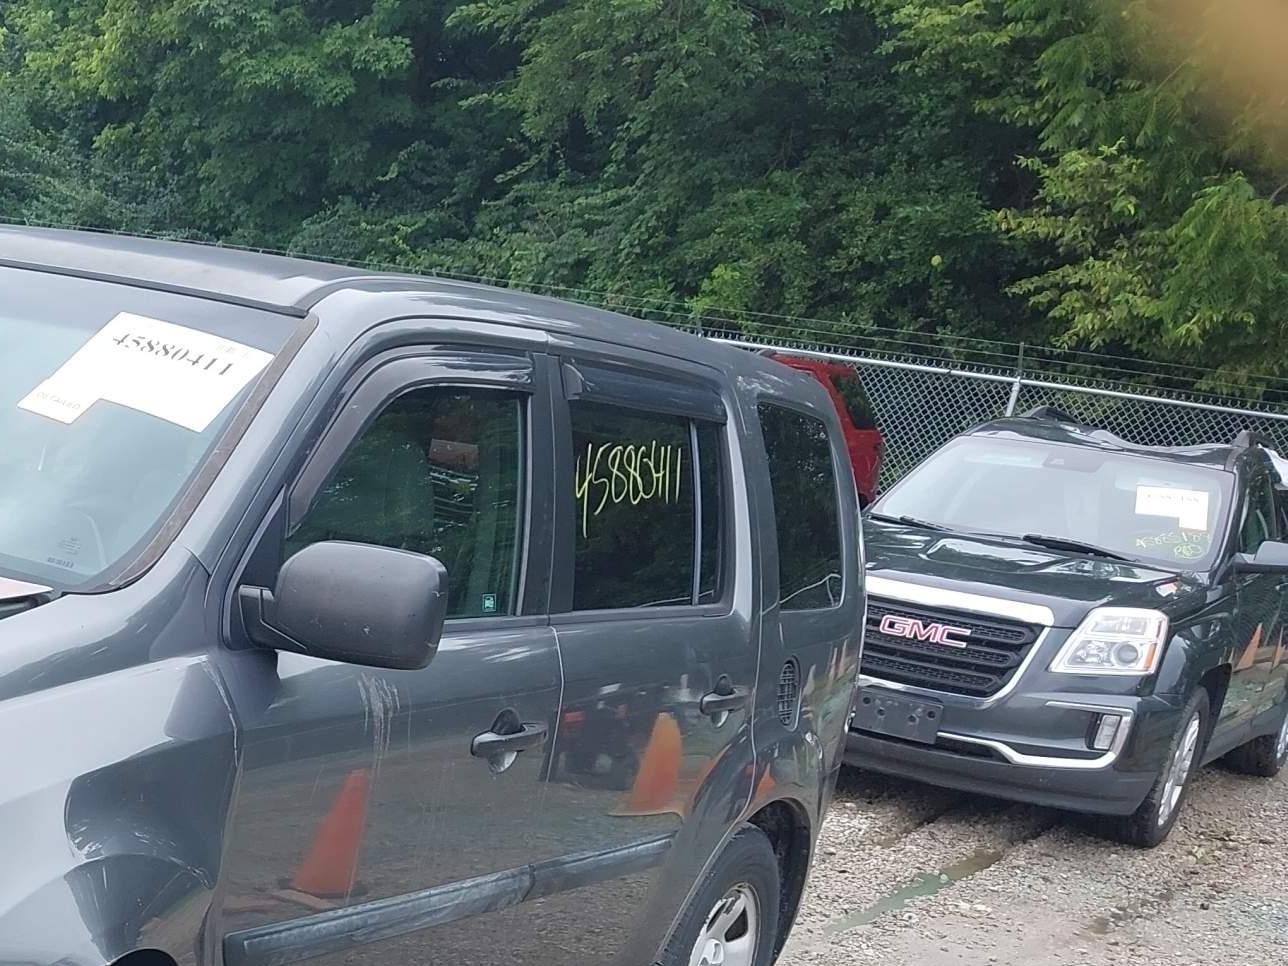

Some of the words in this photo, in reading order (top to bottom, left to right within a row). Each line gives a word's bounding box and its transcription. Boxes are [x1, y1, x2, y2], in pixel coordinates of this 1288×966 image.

[112, 332, 234, 377] 45880411
[575, 440, 681, 539] 45880411
[879, 614, 972, 648] GMC
